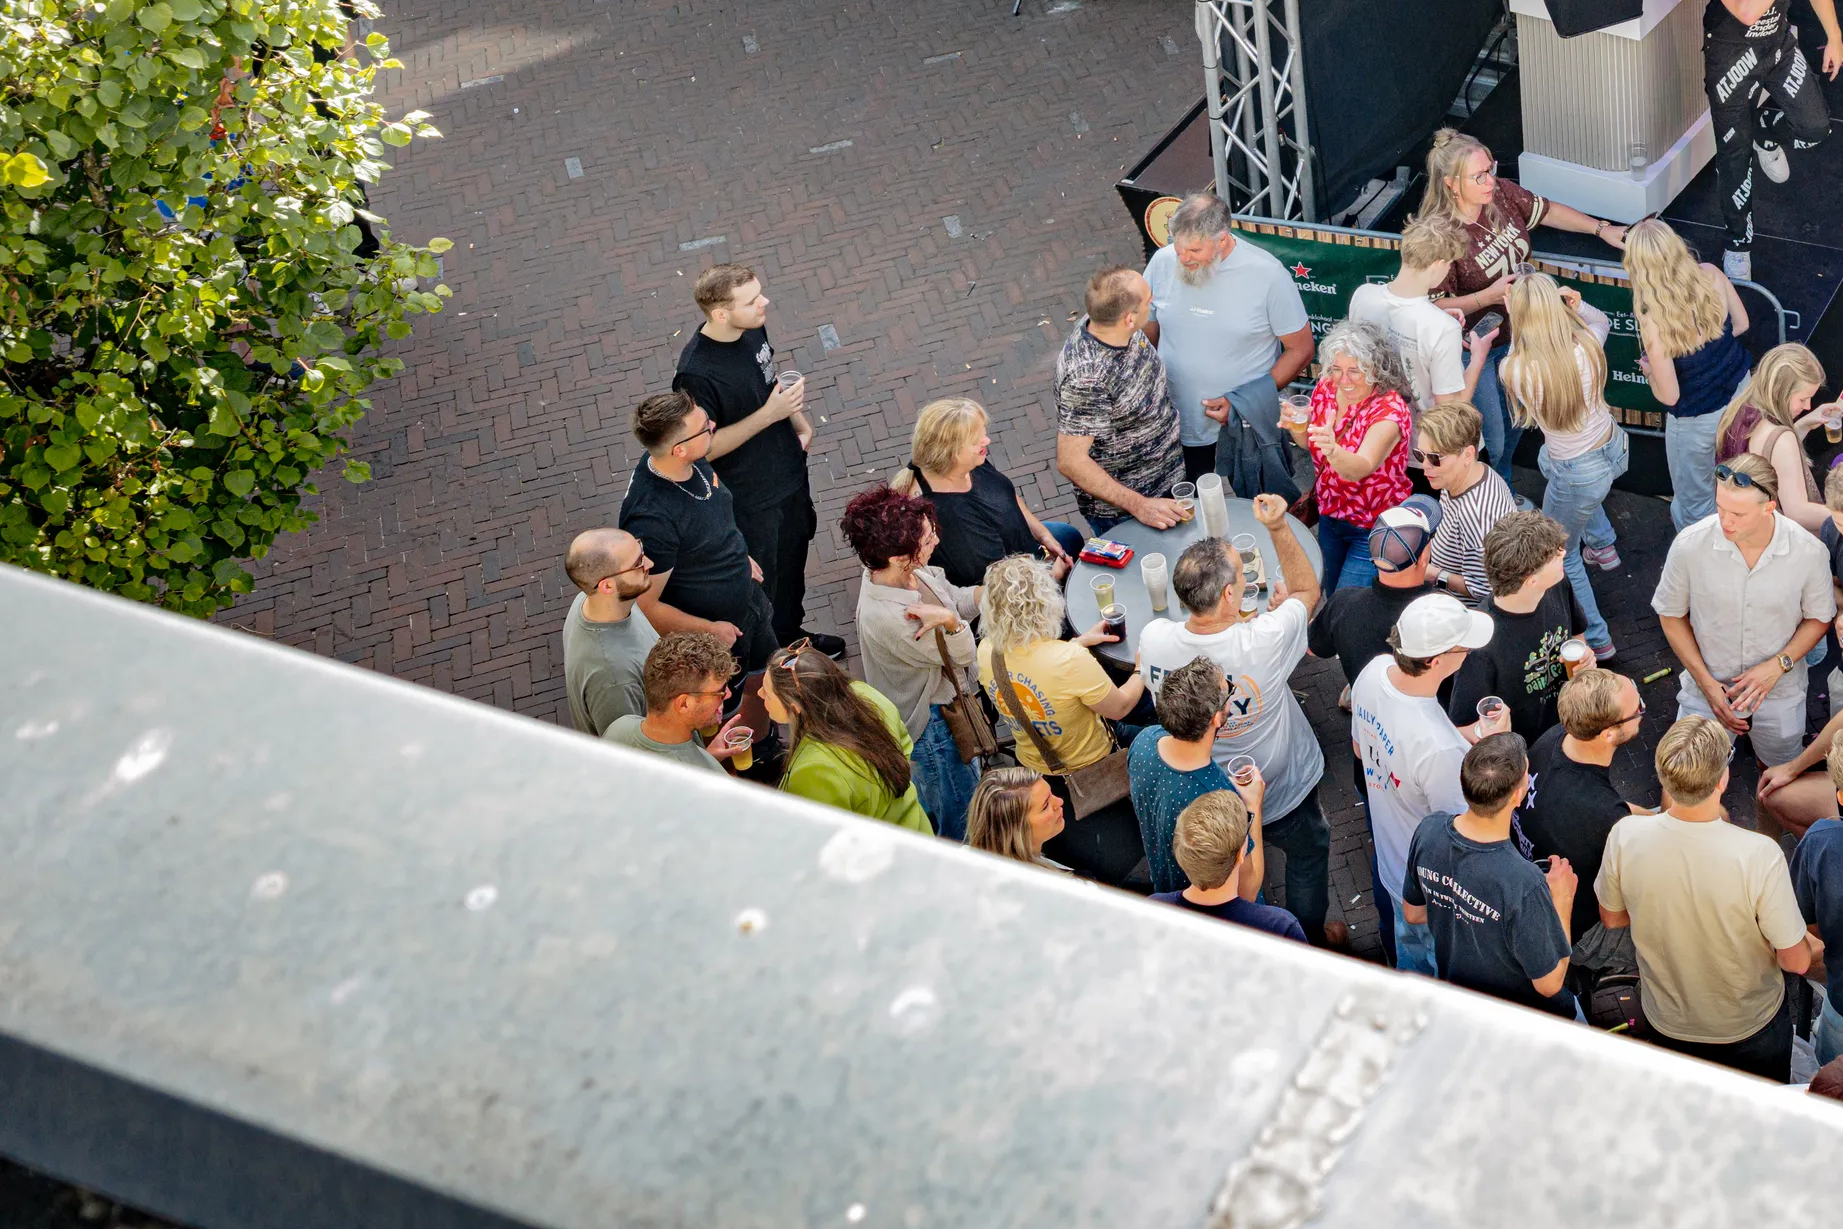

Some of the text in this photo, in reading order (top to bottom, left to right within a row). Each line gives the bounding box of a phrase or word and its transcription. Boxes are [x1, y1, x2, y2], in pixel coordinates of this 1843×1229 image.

[1298, 281, 1337, 295] neken
[1613, 370, 1649, 385] Hein
[1017, 673, 1056, 716] CHASING
[1357, 704, 1376, 726] AILY
[1442, 875, 1501, 921] COLLECTIVE
